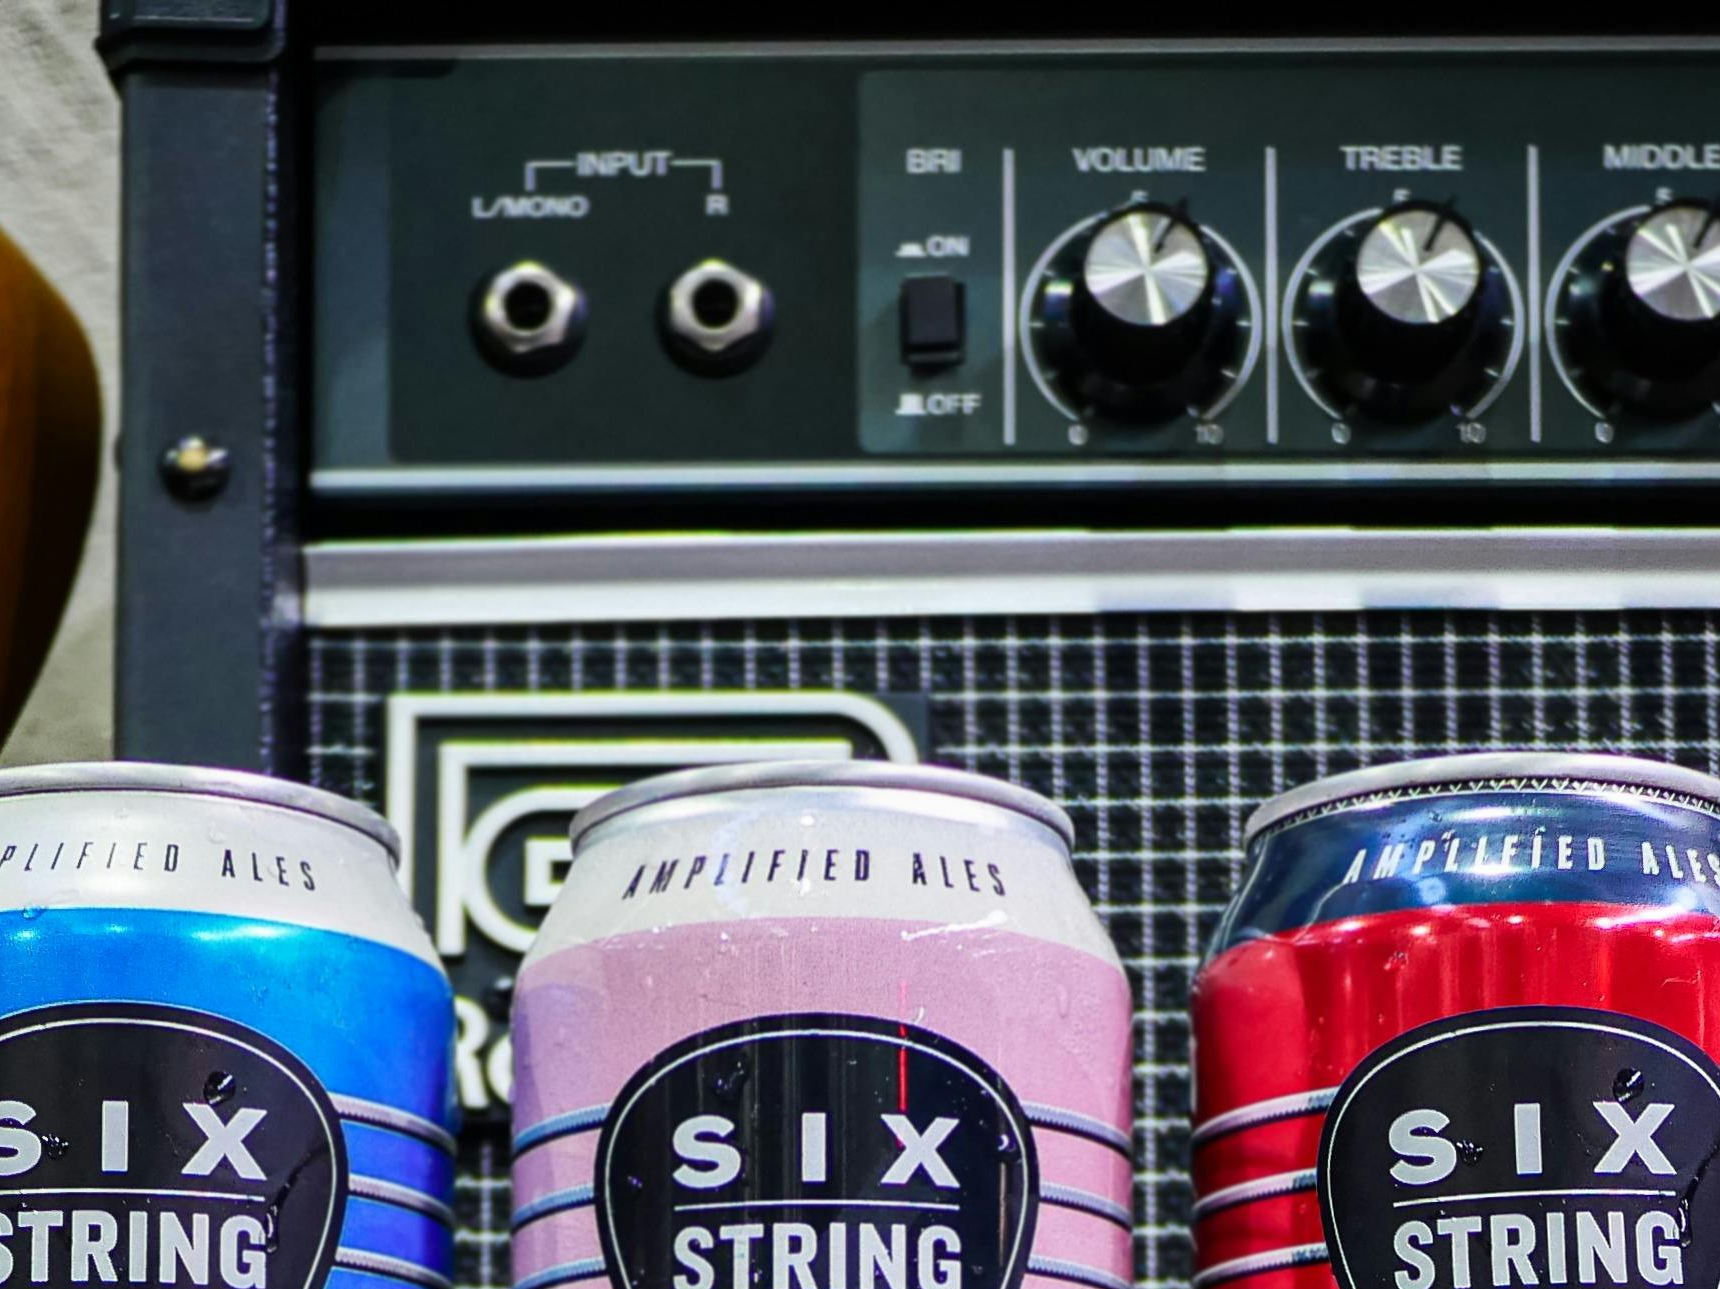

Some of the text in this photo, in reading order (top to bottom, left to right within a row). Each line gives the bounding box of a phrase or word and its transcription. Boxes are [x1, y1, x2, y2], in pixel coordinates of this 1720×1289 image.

[576, 151, 672, 176] INPUT
[906, 149, 962, 173] BRI
[1072, 147, 1206, 172] VOLUME
[1339, 145, 1463, 171] TREBLE
[471, 196, 590, 218] L/MONO
[705, 195, 728, 216] R
[926, 235, 970, 257] ON
[926, 394, 981, 415] OFF
[1196, 424, 1224, 444] 10
[1458, 423, 1485, 443] 10
[222, 849, 316, 892] ALES
[1341, 834, 1605, 886] AMPLIFIED
[622, 848, 1007, 900] AMPLIFIED ALES
[672, 1112, 960, 1189] SIX
[1388, 1102, 1678, 1186] SIX
